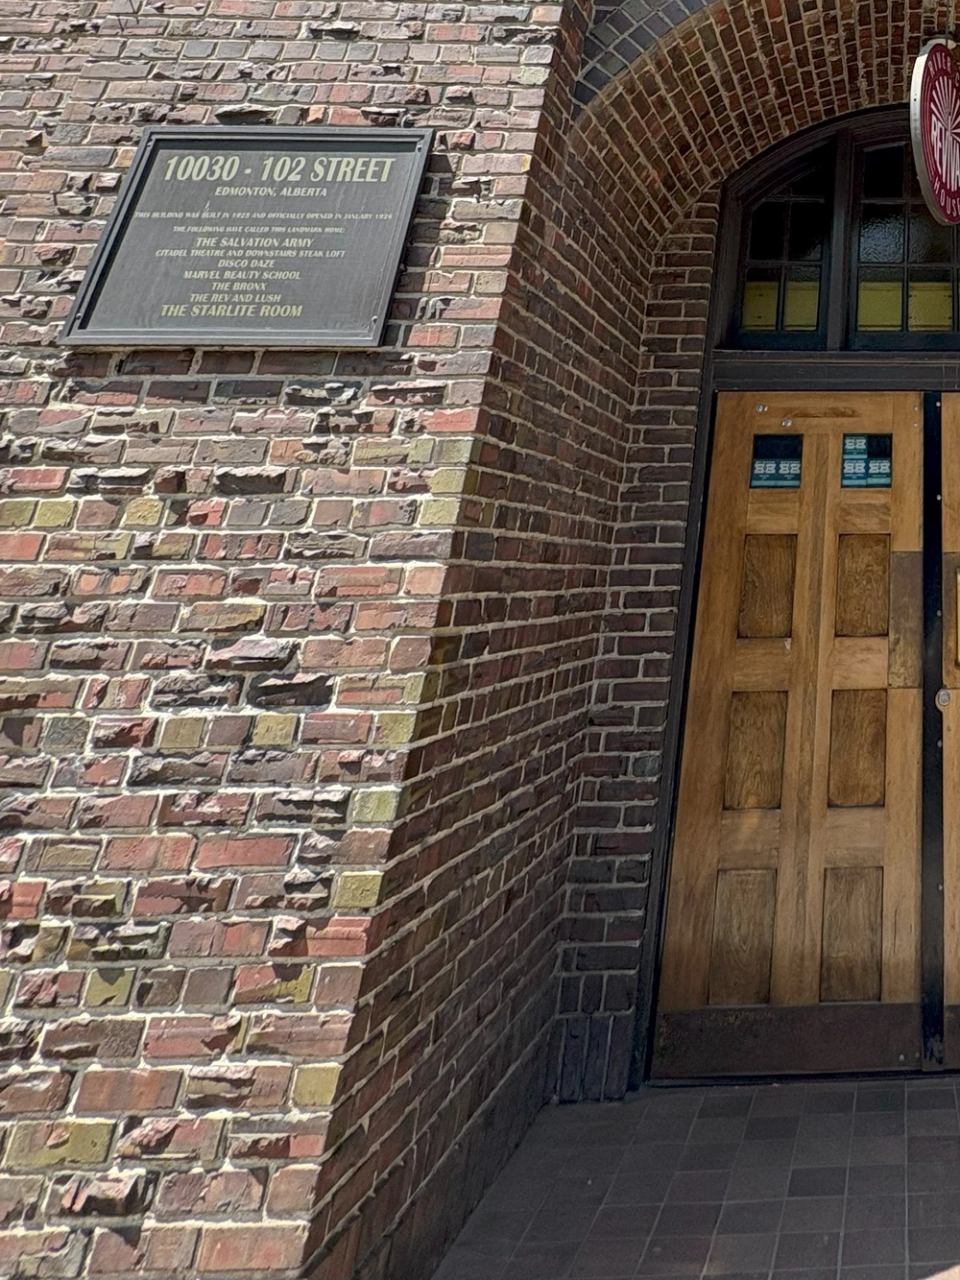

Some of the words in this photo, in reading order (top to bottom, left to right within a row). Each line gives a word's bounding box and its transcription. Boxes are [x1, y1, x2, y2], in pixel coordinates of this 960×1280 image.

[929, 52, 952, 78] RIVER
[164, 155, 240, 181] 10030
[261, 156, 306, 181] 102
[310, 157, 397, 182] STREET
[215, 186, 277, 197] EDMONTON,
[280, 187, 327, 197] ALBERTA
[185, 211, 199, 219] WAS
[201, 211, 221, 219] BUILT
[222, 211, 230, 219] IN
[173, 225, 186, 233] THE
[186, 225, 224, 233] FOLLOWING
[287, 226, 323, 234] LANDMARK
[195, 237, 217, 247] THE
[219, 237, 280, 248] SALVATION
[282, 238, 314, 248] ARMY
[190, 250, 226, 258] THEATRE
[227, 250, 243, 258] AND
[245, 250, 297, 258] DOWNSTAIRS
[299, 250, 323, 258] STEAK
[325, 250, 346, 258] LOFT
[218, 259, 248, 268] DISCO
[250, 259, 276, 269] DAZE
[183, 270, 221, 279] MARVEL
[223, 271, 260, 279] BEAUTY
[262, 271, 302, 280] SCHOOL
[211, 282, 230, 291] THE
[232, 282, 267, 291] BRONX
[190, 293, 209, 302] THE
[210, 293, 232, 302] REV
[231, 293, 253, 303] AND
[255, 294, 281, 303] LUSH
[160, 304, 188, 317] THE
[190, 304, 257, 317] STARLITE
[259, 305, 303, 317] ROOM
